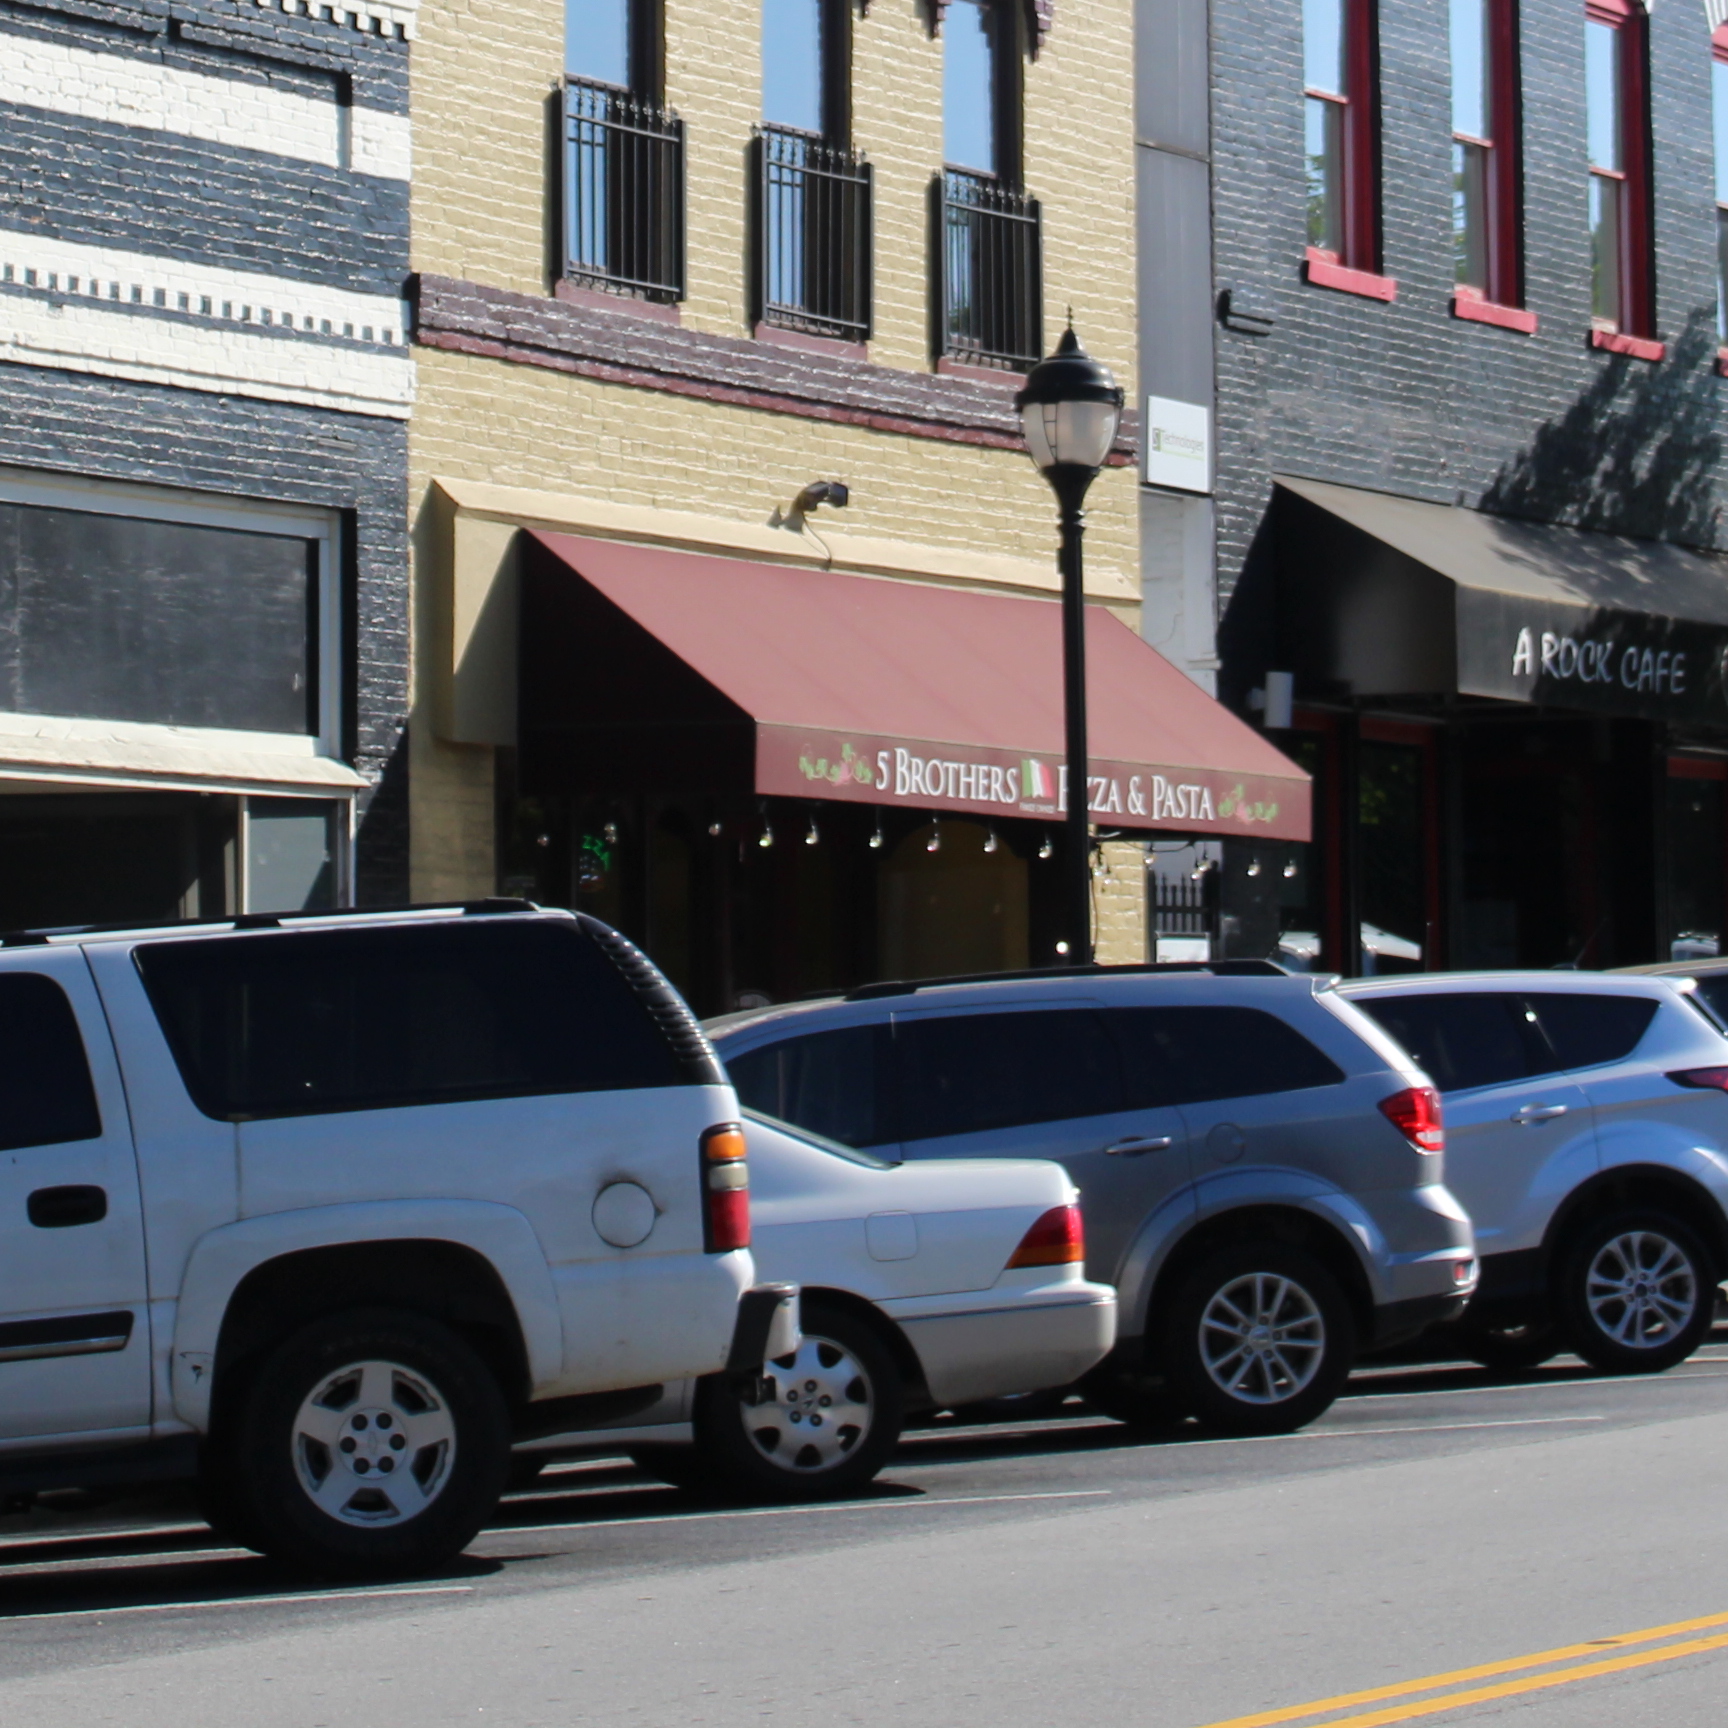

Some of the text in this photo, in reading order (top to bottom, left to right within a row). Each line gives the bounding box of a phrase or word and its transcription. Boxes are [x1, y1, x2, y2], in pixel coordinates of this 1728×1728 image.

[1512, 626, 1687, 695] A ROCK CAFE
[875, 746, 1216, 821] 5 BROTHERS PZA & PASTA
